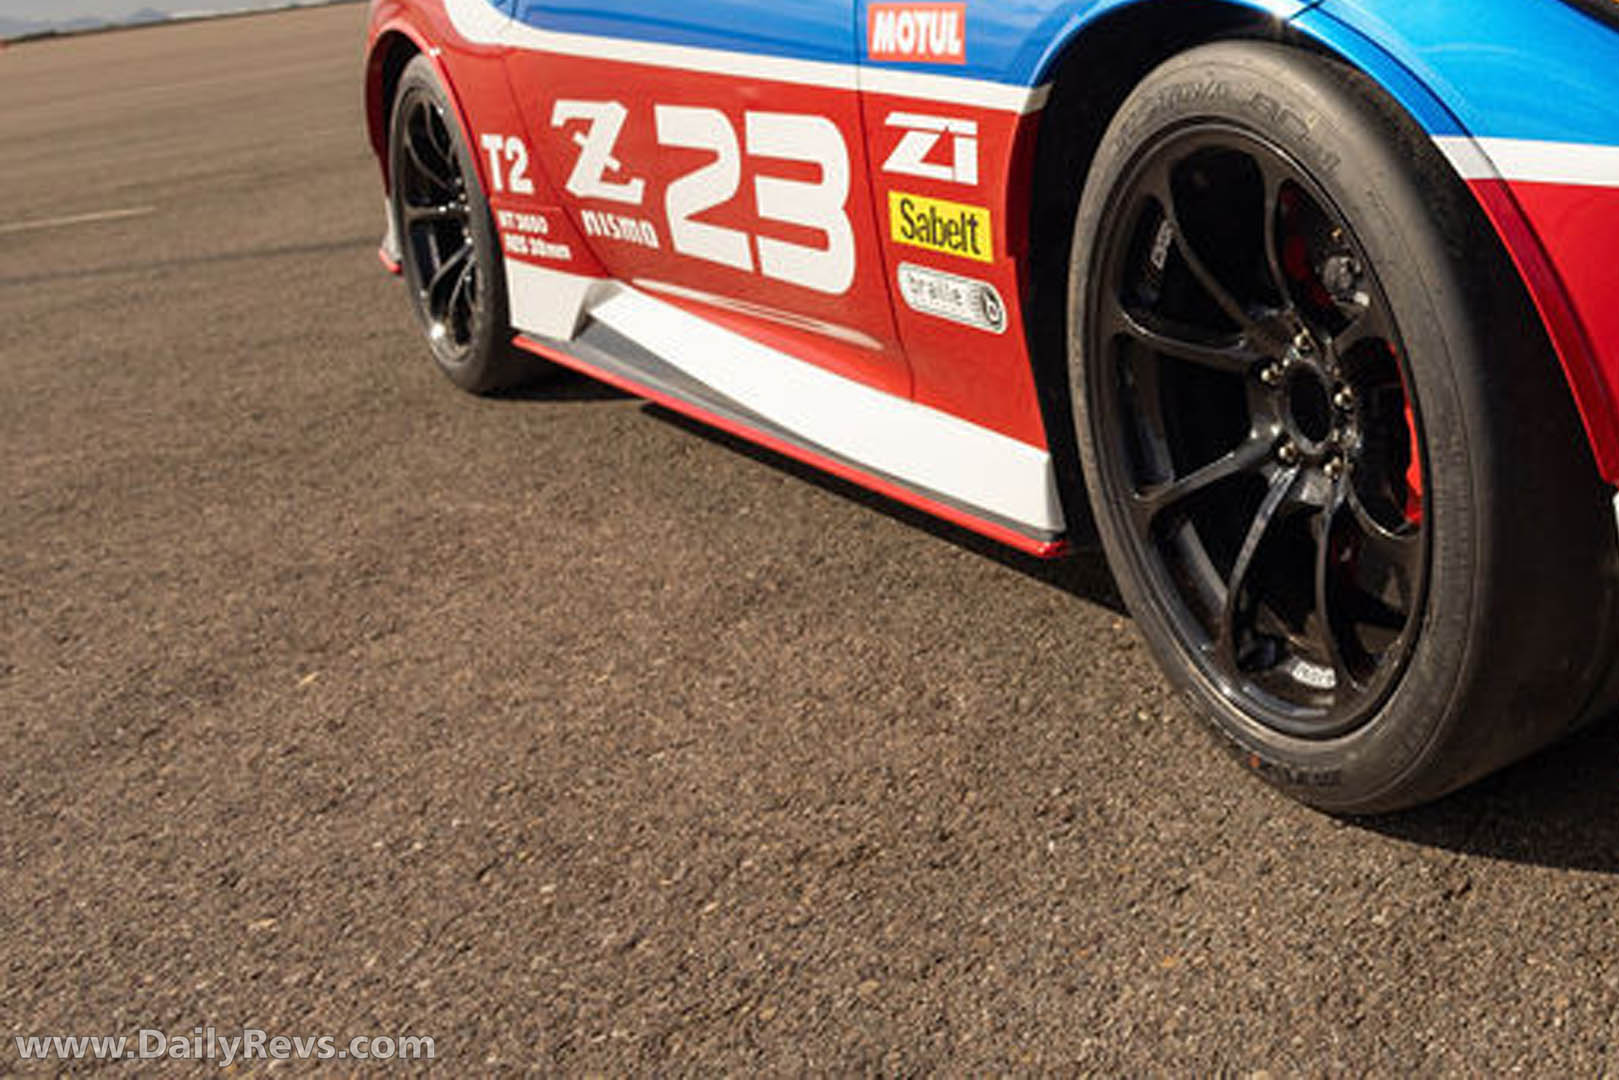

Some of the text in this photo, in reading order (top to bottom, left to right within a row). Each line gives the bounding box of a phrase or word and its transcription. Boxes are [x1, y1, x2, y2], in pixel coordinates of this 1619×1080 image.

[871, 7, 962, 56] MOTUL
[480, 133, 535, 195] T2
[653, 103, 857, 296] 23
[900, 197, 982, 256] Sabelt
